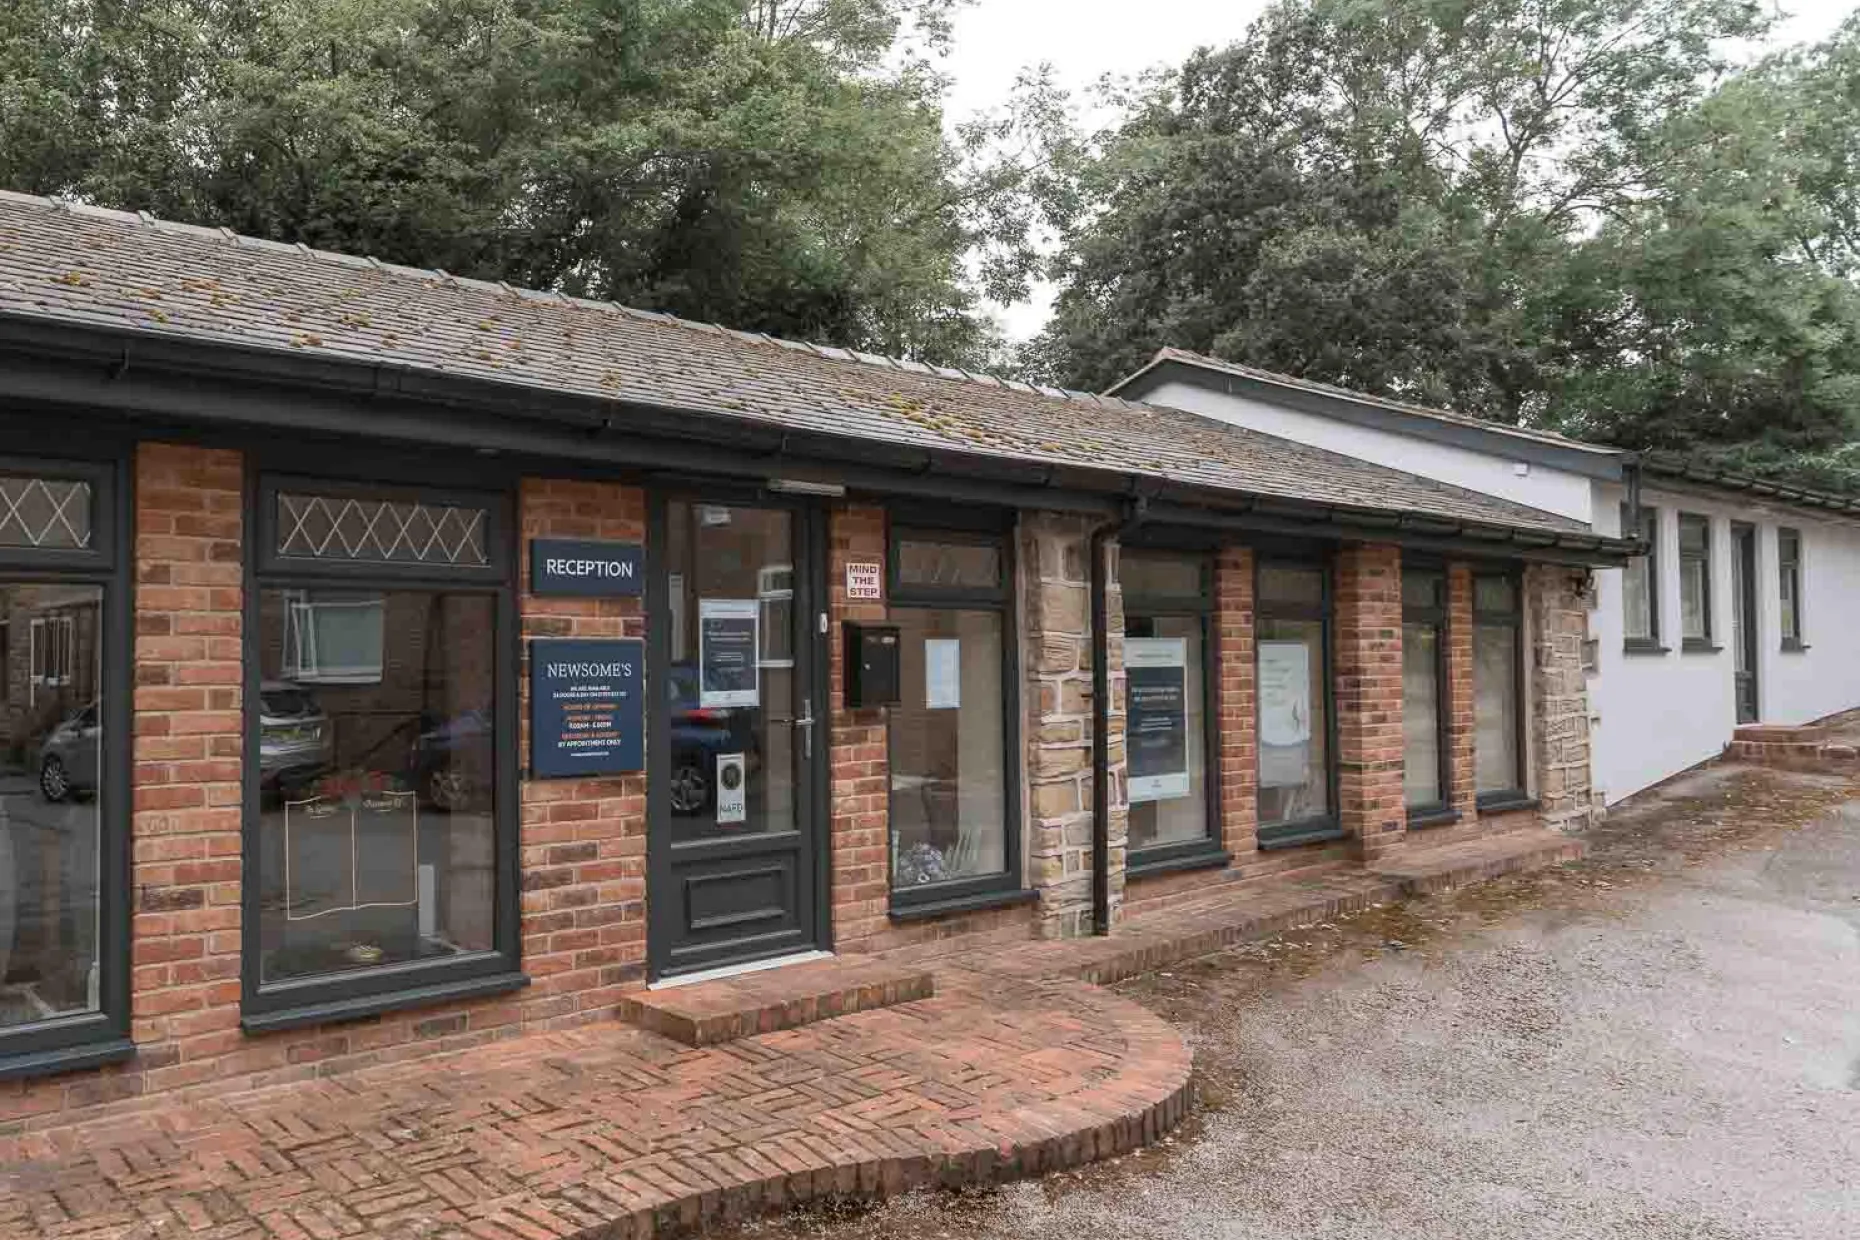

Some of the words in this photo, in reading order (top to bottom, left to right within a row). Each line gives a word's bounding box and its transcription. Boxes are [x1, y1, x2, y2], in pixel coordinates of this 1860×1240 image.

[546, 558, 633, 578] RECEPTION
[850, 565, 877, 573] MIND
[851, 576, 875, 585] THE
[850, 587, 877, 596] STEP
[547, 662, 632, 678] NEWSOME'S
